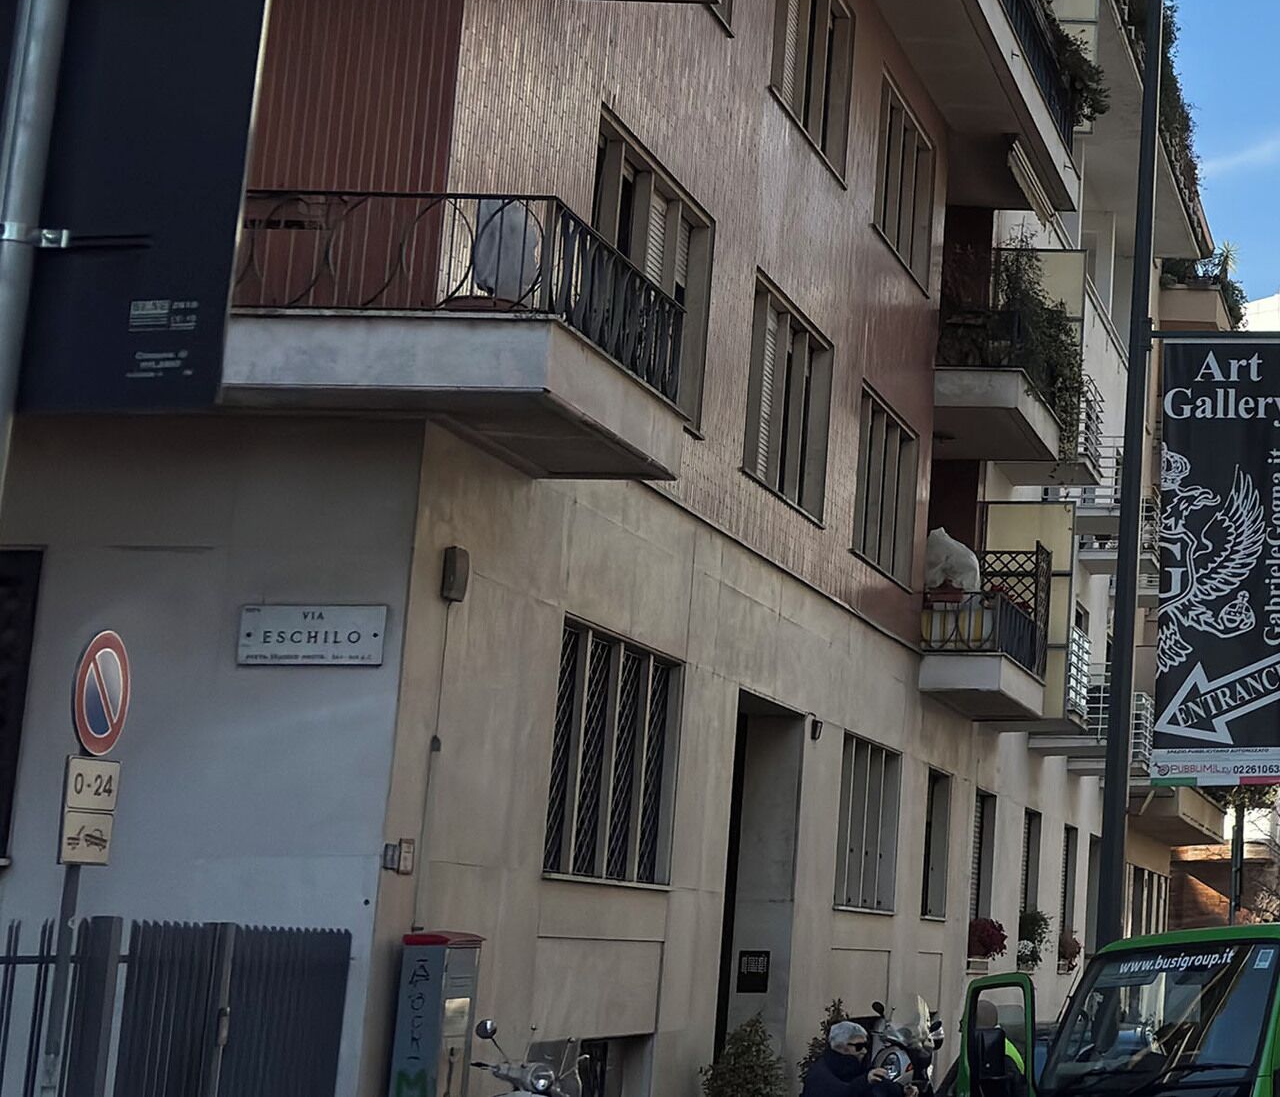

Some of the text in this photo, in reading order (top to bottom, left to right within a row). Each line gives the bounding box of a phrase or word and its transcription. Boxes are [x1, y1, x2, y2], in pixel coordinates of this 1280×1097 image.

[1194, 350, 1263, 382] Art
[302, 611, 324, 620] VIA
[262, 630, 361, 644] ESCHILO
[1119, 947, 1235, 973] www.busigroup.it
